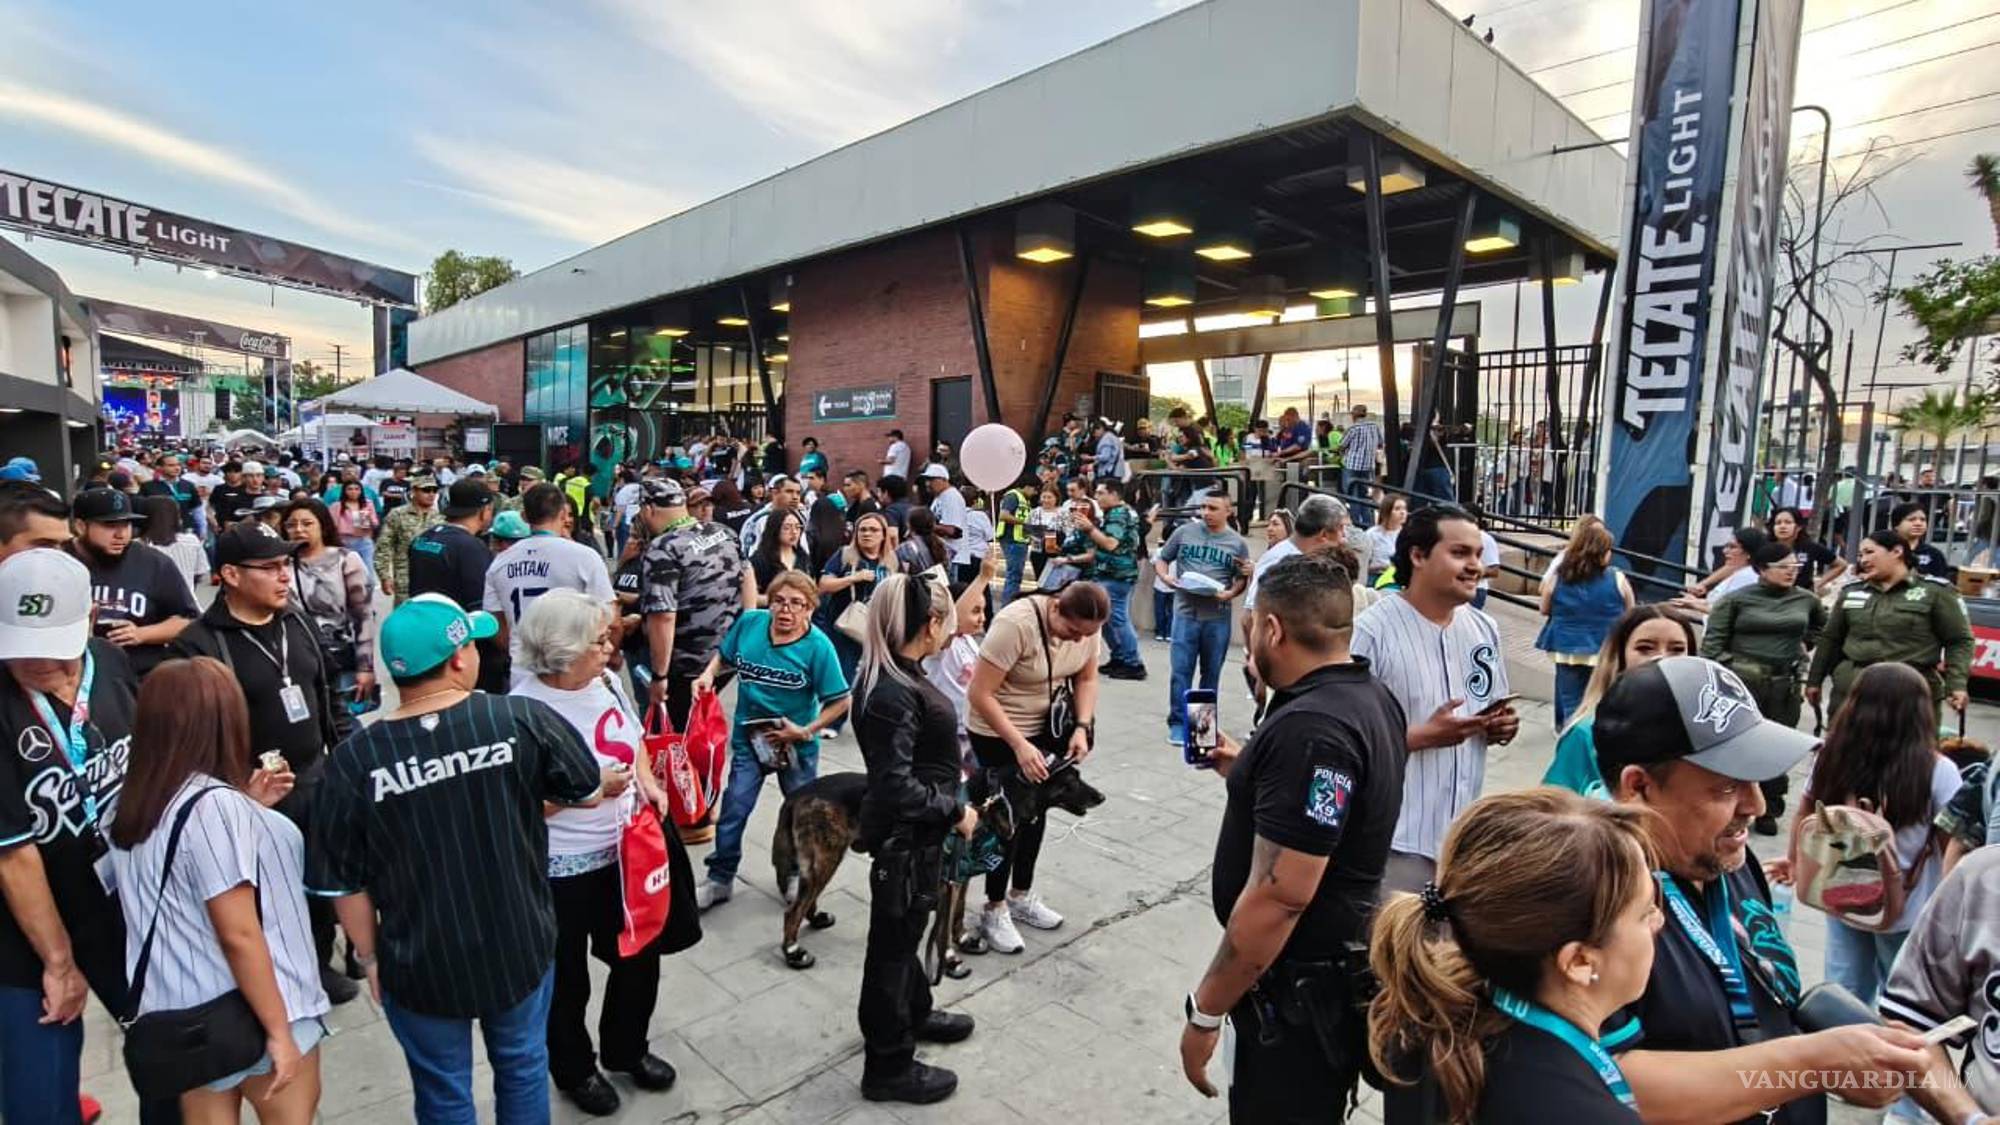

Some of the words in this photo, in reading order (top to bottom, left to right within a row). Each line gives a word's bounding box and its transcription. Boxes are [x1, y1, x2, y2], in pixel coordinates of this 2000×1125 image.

[1663, 89, 1702, 214] LIGHT
[0, 173, 152, 244] TECATE
[156, 222, 231, 252] LIGHT
[1622, 222, 1706, 431] TECATE
[507, 560, 551, 579] OHTANI
[1181, 543, 1232, 569] SALTILLO
[1465, 643, 1495, 702] S
[370, 737, 516, 802] Alianza
